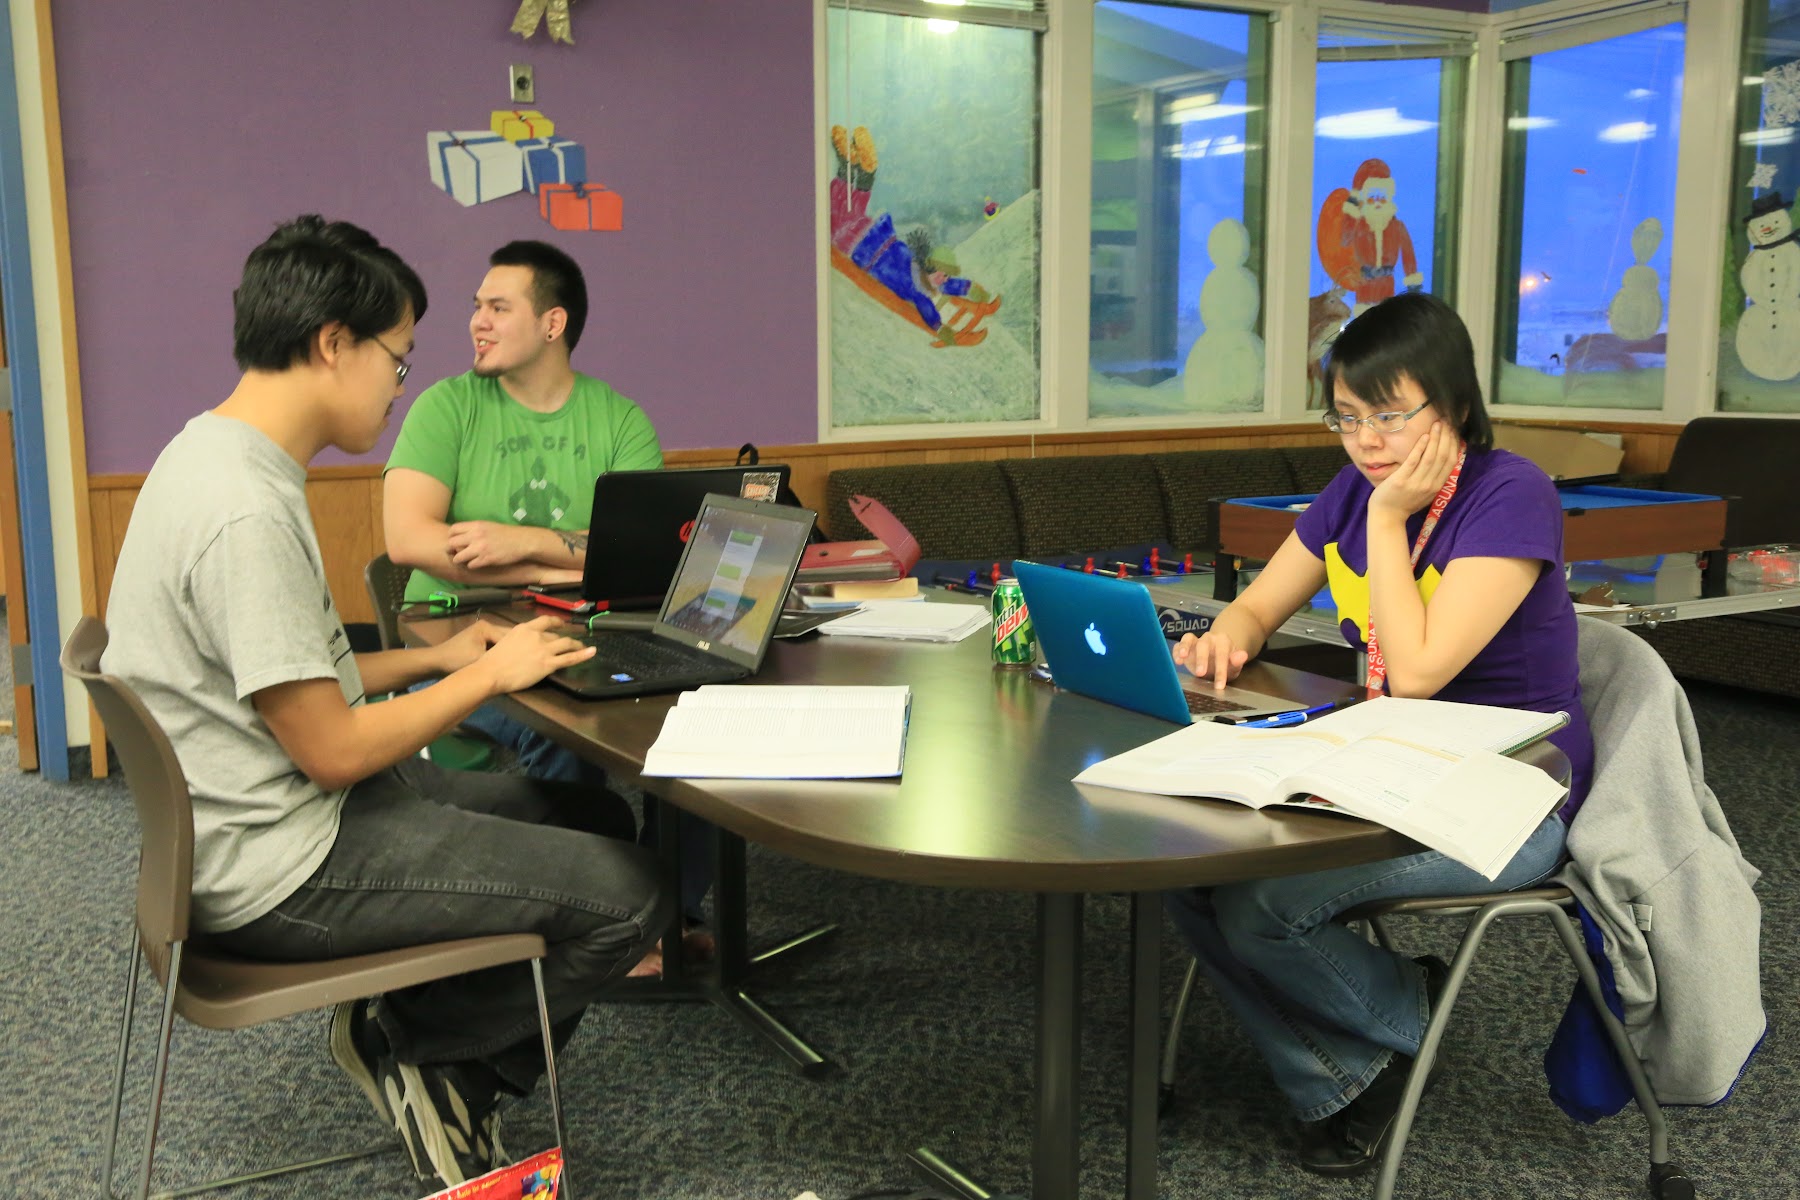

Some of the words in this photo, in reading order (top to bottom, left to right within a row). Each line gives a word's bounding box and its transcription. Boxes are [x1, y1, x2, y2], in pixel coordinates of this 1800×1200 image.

[495, 436, 532, 460] SON
[542, 436, 568, 451] OF
[573, 443, 587, 461] A
[1432, 474, 1459, 518] ASUNA
